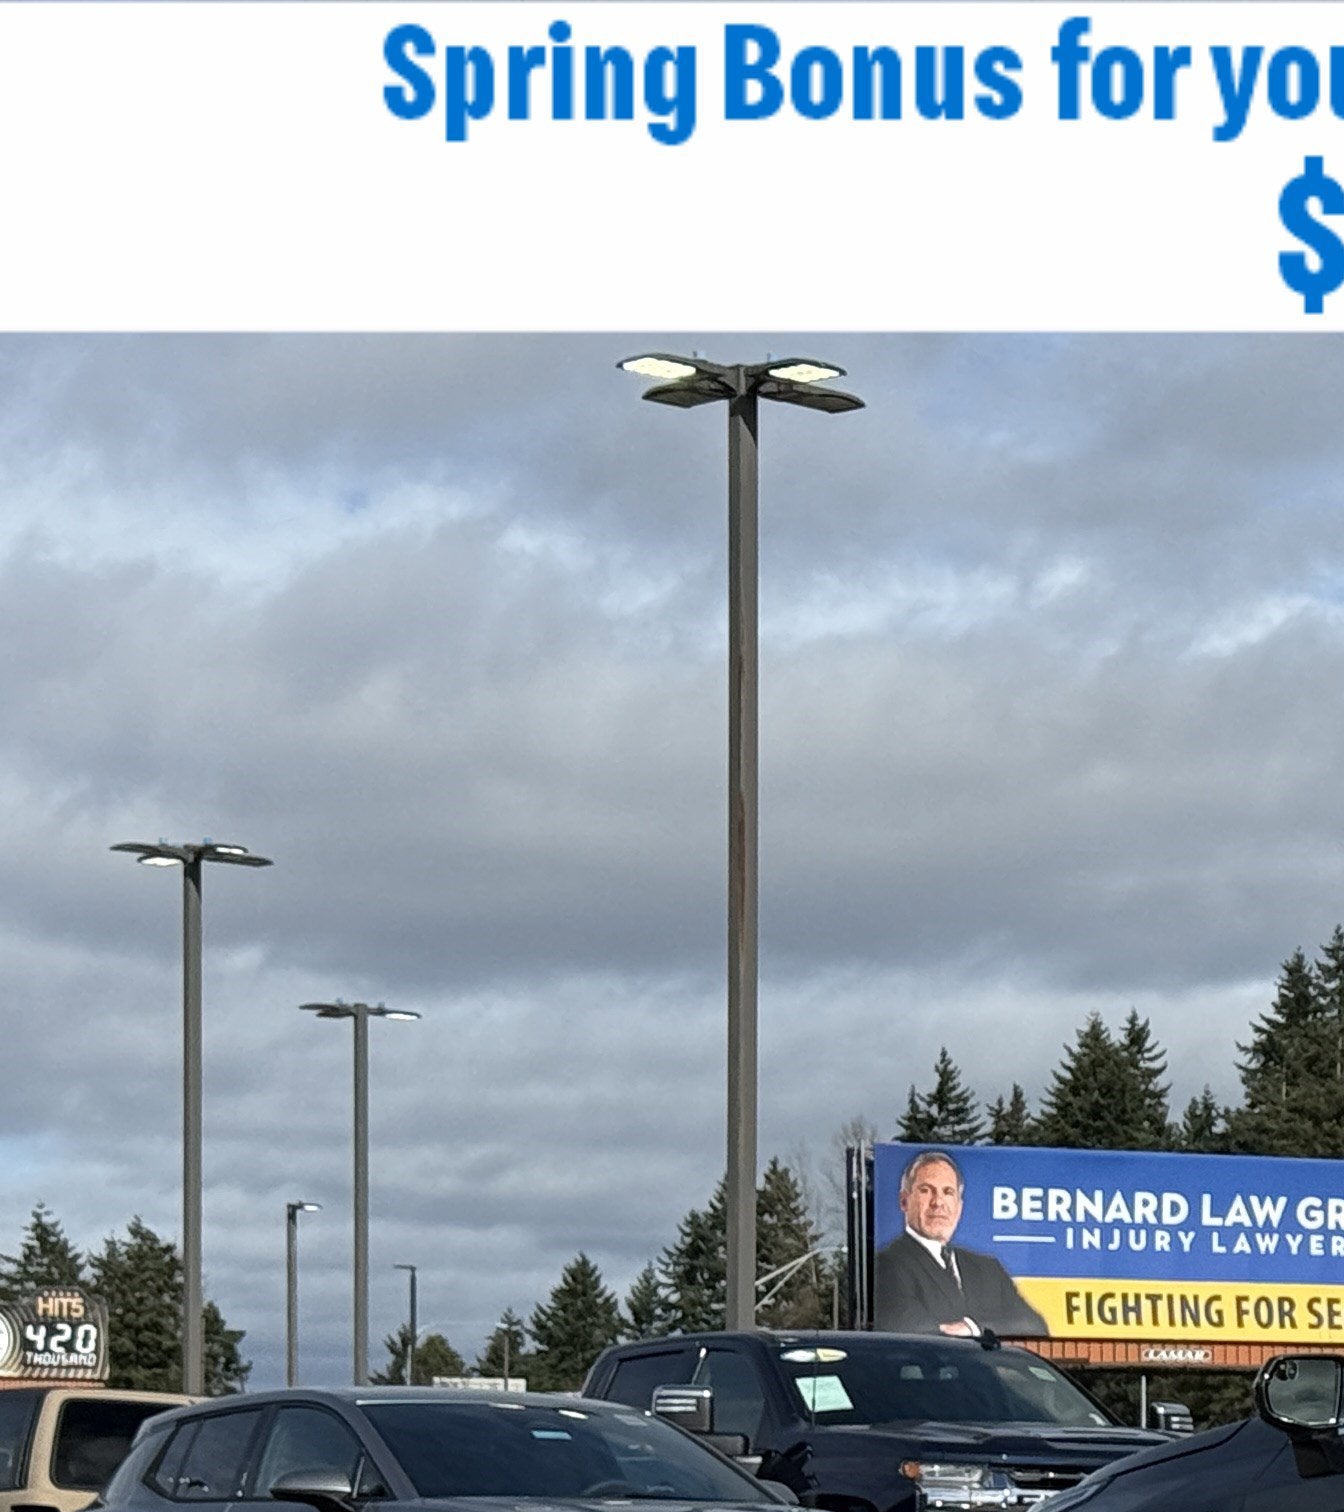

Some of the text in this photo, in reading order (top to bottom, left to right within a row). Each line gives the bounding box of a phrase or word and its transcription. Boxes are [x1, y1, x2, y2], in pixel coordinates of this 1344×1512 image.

[992, 1186, 1190, 1226] BERNARD
[1201, 1193, 1287, 1229] LAW
[1065, 1227, 1197, 1254] INJURY
[36, 1295, 85, 1318] HITS
[1064, 1290, 1226, 1330] FIGHTING
[1235, 1295, 1297, 1330] FOR
[25, 1322, 97, 1353] 420
[25, 1350, 97, 1367] THOUSAND
[1147, 1348, 1207, 1362] LAMAR
